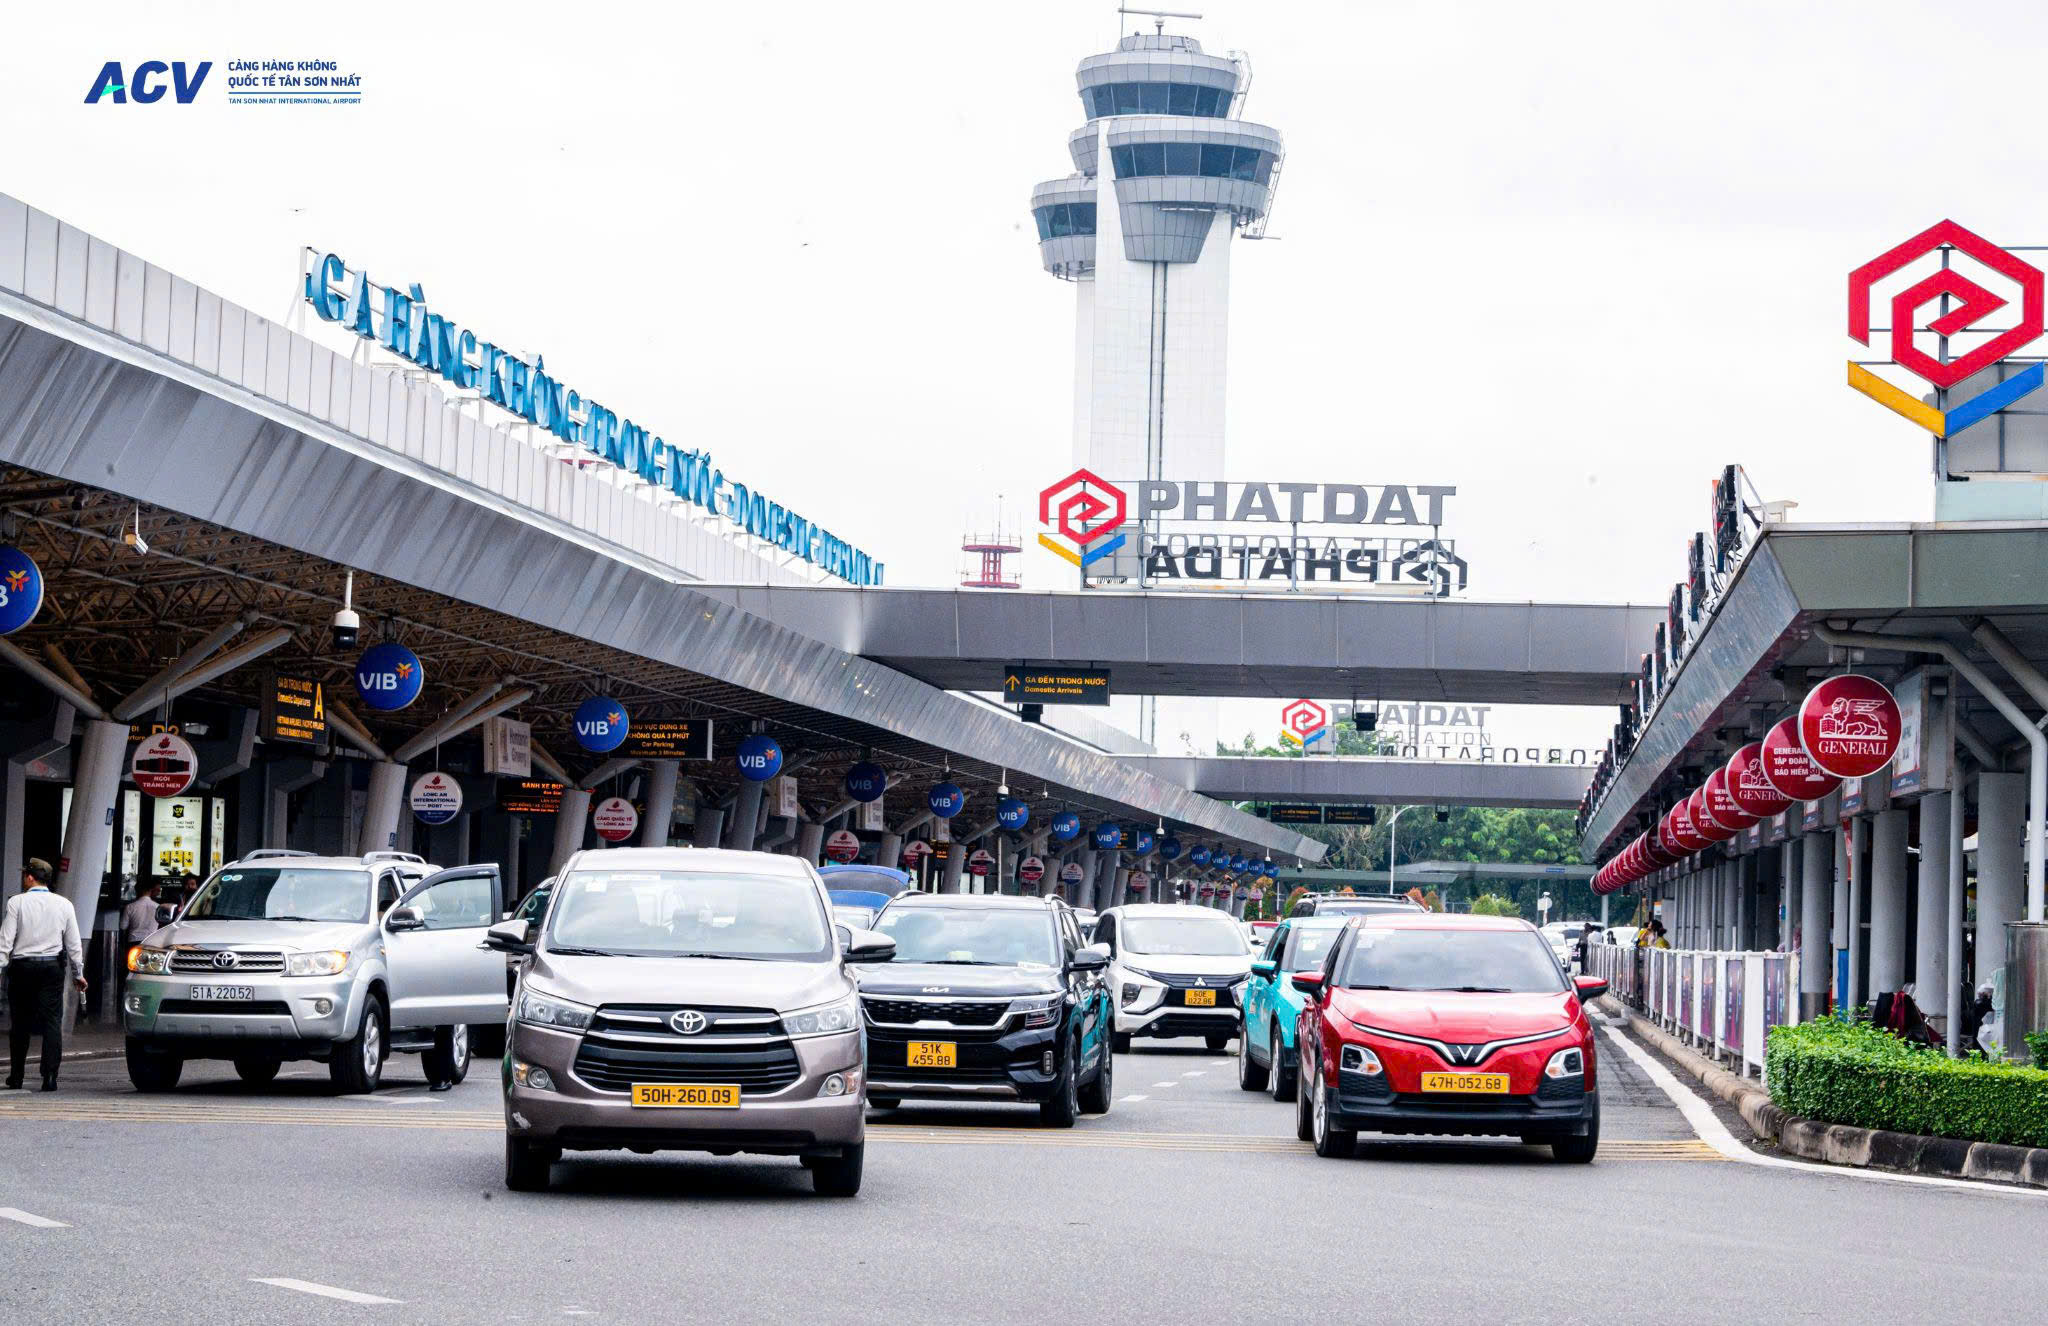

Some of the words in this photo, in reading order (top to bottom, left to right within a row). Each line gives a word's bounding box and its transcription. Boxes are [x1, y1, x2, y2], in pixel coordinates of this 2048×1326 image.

[311, 253, 375, 340] GA
[380, 282, 482, 389] HÀNG
[480, 342, 580, 443] KHÔNG
[581, 399, 666, 486] TRONG
[1138, 480, 1456, 527] PHATDAT
[1137, 533, 1455, 564] CORPORATION
[359, 672, 398, 690] VIB
[1056, 677, 1082, 685] TRONG
[314, 682, 324, 720] A
[577, 720, 610, 735] VIB
[1818, 741, 1887, 755] GENERALI
[739, 755, 766, 768] VIB
[849, 780, 872, 790] VIB
[931, 798, 952, 807] VIB
[1000, 812, 1018, 820] VIB
[1053, 823, 1071, 832] VIB
[911, 1044, 942, 1054] 51K
[912, 1055, 950, 1065] 455.88
[1429, 1077, 1501, 1090] 47H-052.68
[641, 1088, 731, 1103] 50H-260.09
